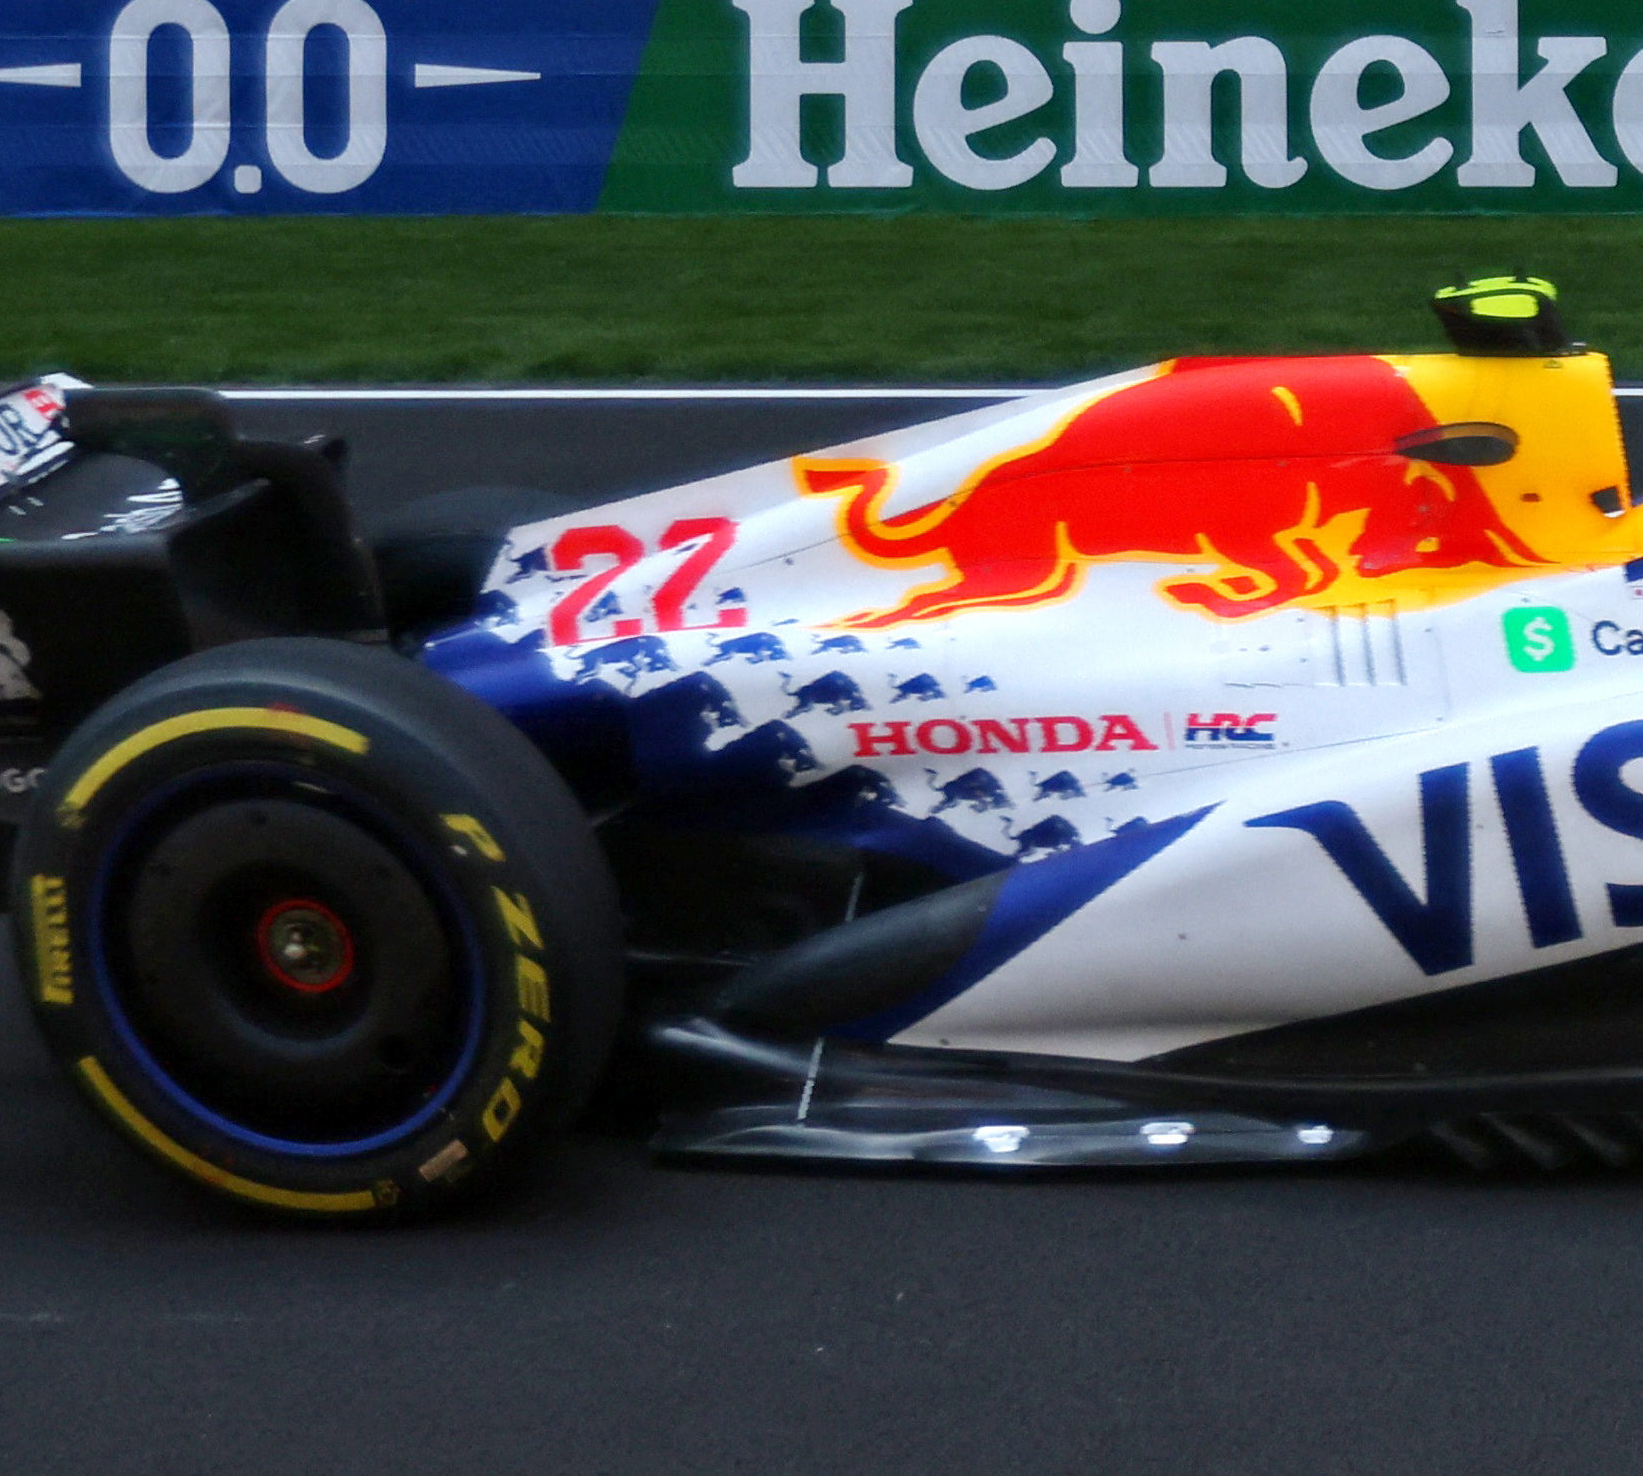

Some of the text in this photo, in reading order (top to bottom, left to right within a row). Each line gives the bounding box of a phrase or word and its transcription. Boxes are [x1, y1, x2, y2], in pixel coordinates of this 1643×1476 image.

[850, 711, 1279, 759] HONDA HRC
[481, 885, 552, 1144] ZERO
